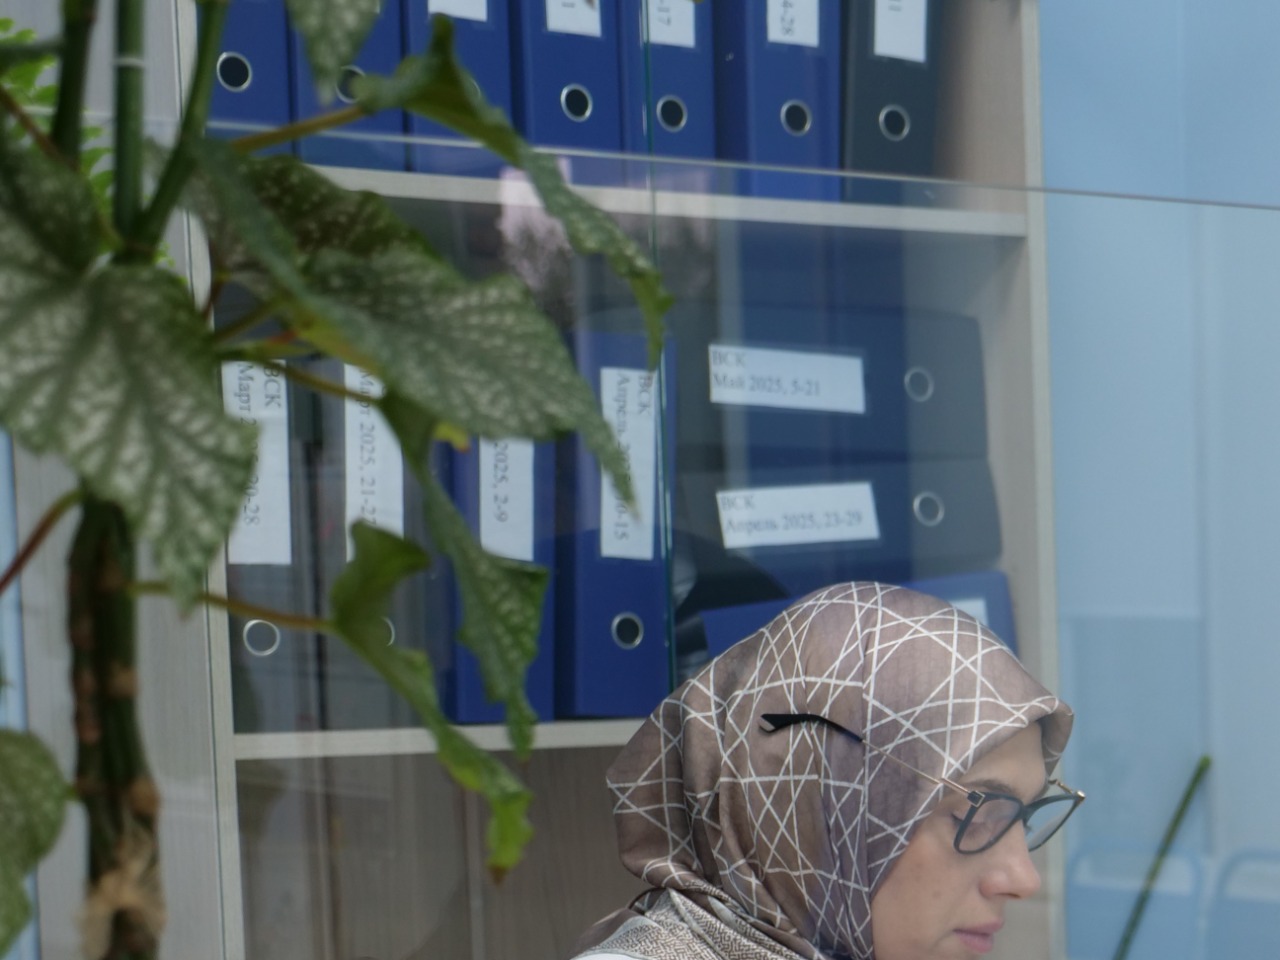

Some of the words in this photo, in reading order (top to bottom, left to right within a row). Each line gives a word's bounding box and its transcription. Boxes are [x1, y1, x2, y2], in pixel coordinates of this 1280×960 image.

[234, 364, 254, 412] Март
[748, 375, 788, 396] 2025,
[358, 423, 376, 472] 2025,
[493, 494, 509, 523] 2-9
